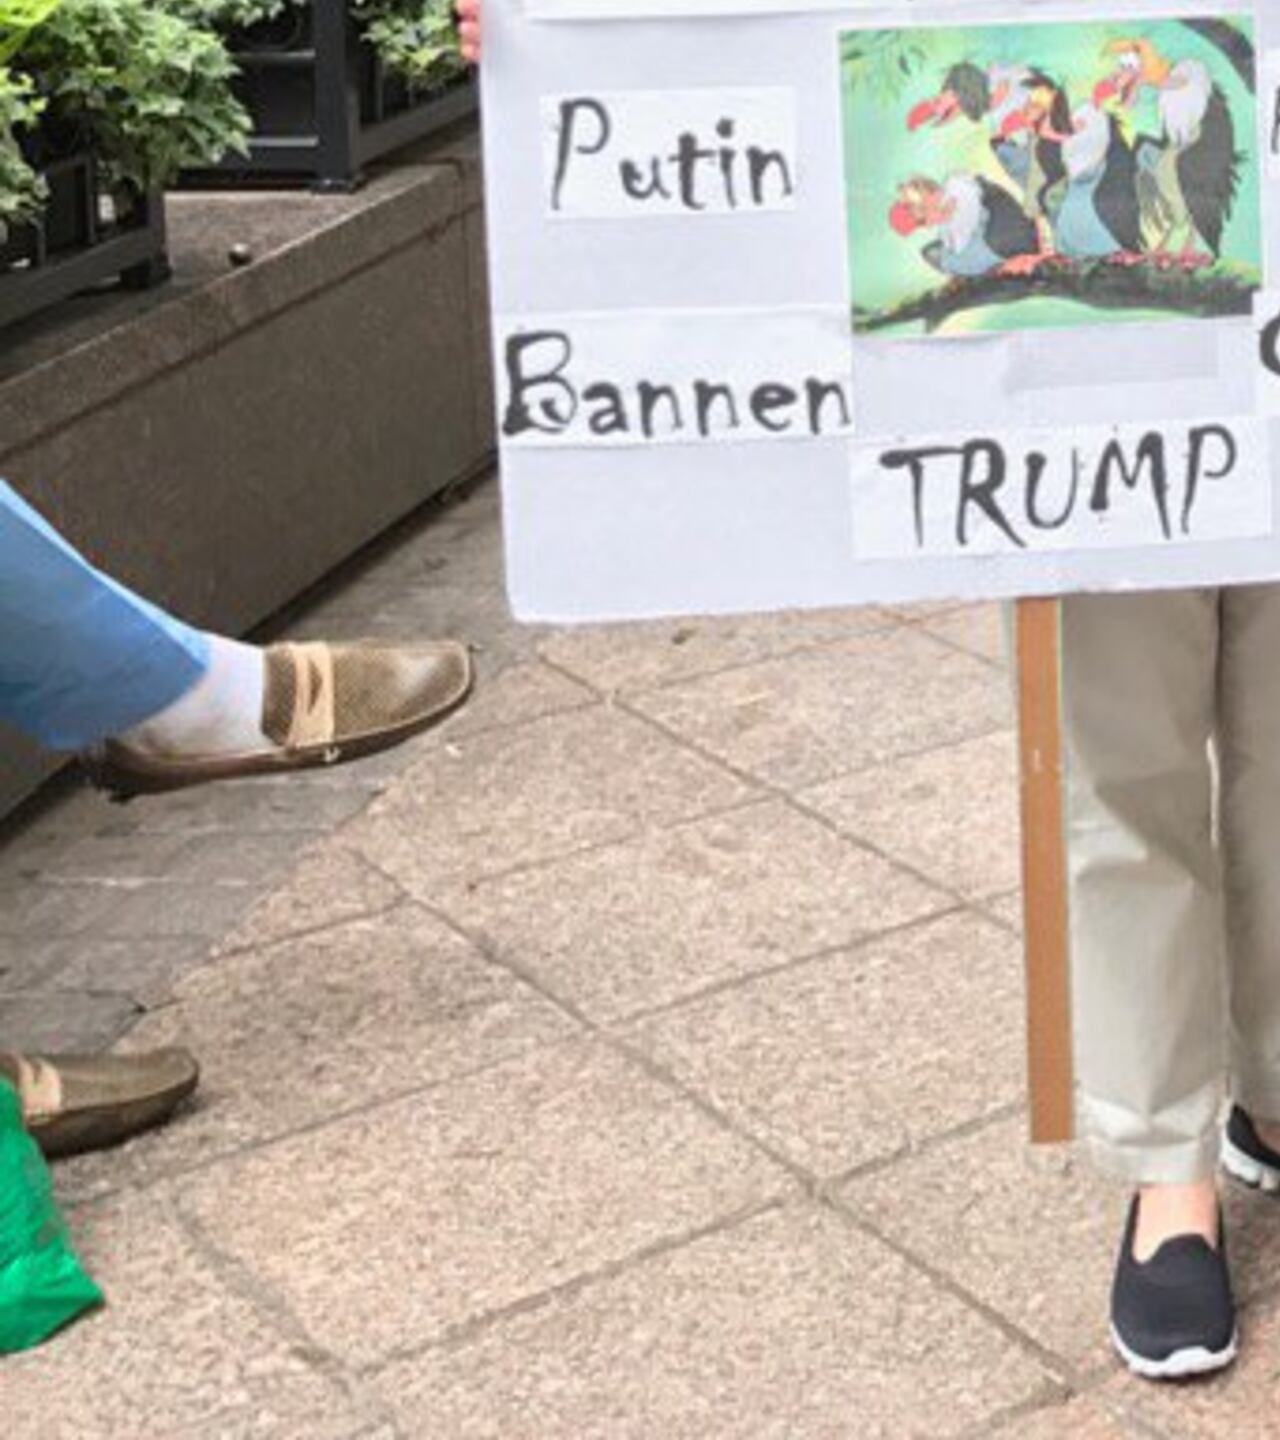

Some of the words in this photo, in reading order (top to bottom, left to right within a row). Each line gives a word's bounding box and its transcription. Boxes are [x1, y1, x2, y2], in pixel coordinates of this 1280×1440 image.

[550, 96, 795, 211] Putin
[501, 330, 852, 438] Bannen
[877, 424, 1238, 549] TRUMP
